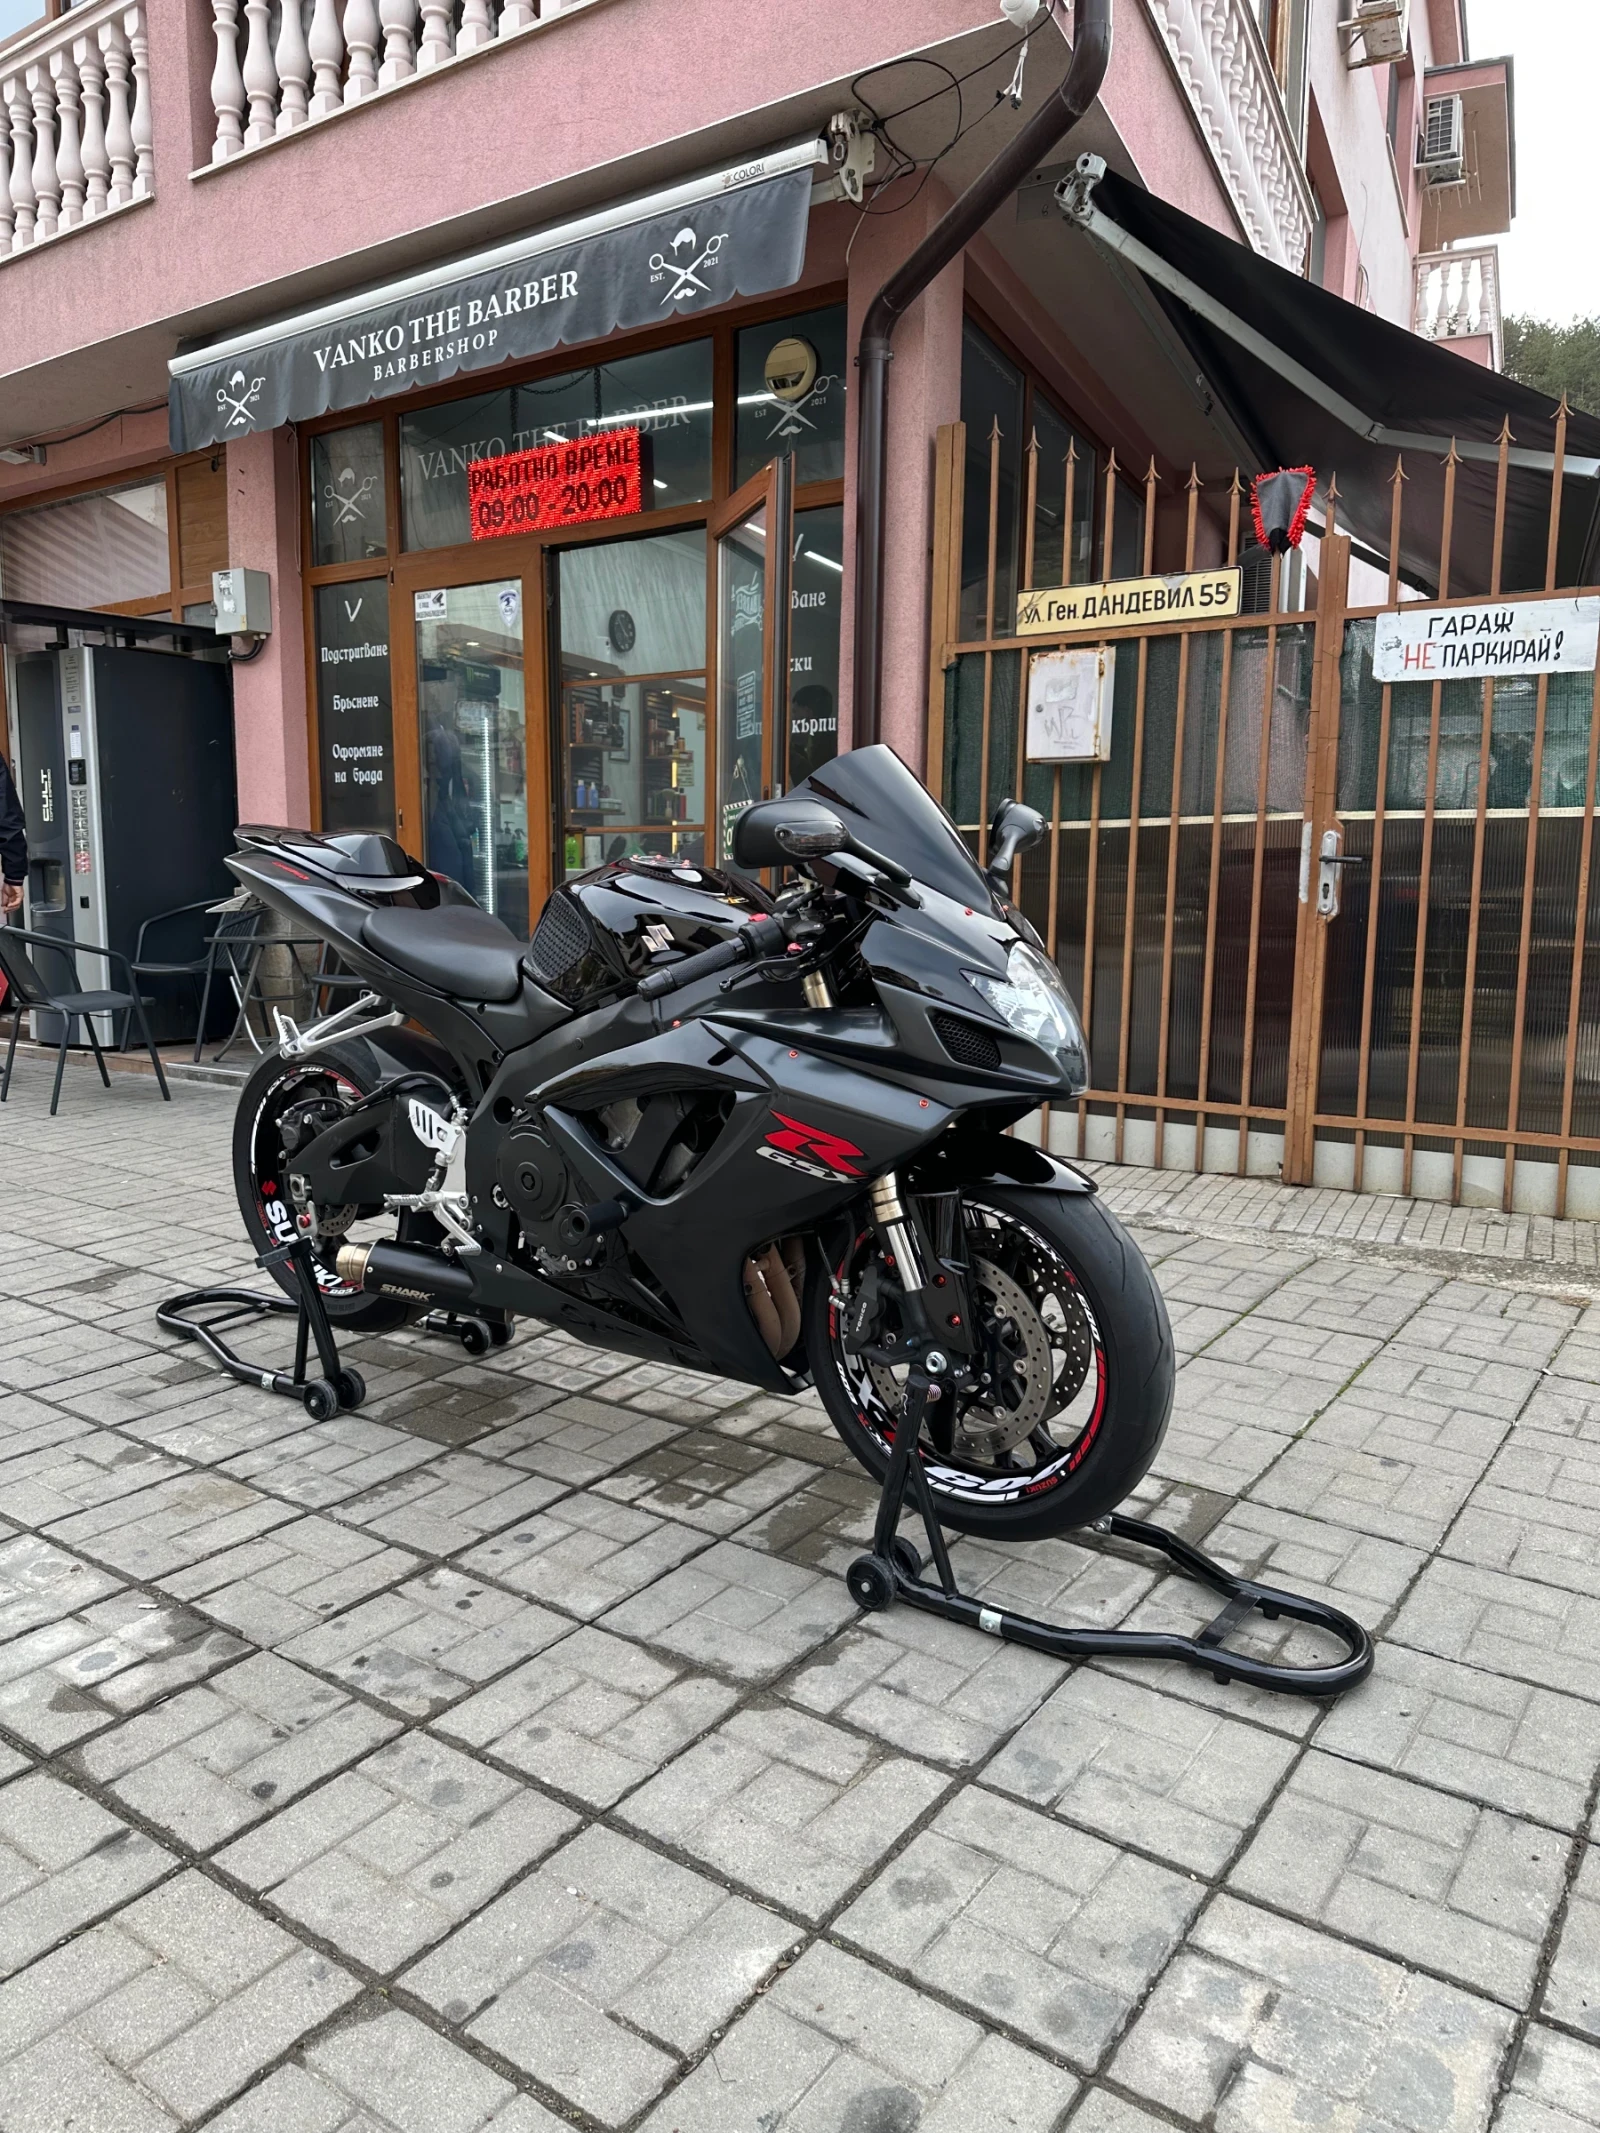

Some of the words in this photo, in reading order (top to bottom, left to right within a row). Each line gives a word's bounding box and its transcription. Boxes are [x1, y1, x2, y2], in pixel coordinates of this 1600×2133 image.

[733, 163, 765, 181] COLORI
[703, 256, 719, 269] 2021
[313, 325, 404, 372] VANKO
[408, 305, 461, 345] THE
[466, 270, 579, 327] BARBER
[373, 329, 498, 381] BARBERSHOP
[418, 437, 506, 480] VANKO
[472, 454, 559, 493] РАБОТНО
[565, 437, 635, 475] ВРЕМЕ
[479, 491, 540, 529] 09:00
[562, 474, 628, 515] 20:00
[1047, 600, 1080, 621] Ген.
[1082, 586, 1195, 619] ДАНДЕВИЛ
[1199, 581, 1231, 606] 55
[1428, 611, 1515, 638] ГАРАЖ
[321, 642, 388, 665] Подстригване
[1404, 642, 1438, 670] НЕ
[333, 695, 379, 713] Бръснене
[791, 717, 837, 736] кърпи
[332, 743, 384, 761] Оформяне
[335, 770, 347, 783] на
[353, 767, 383, 785] брада
[41, 769, 50, 821] CULT
[300, 1066, 324, 1074] 600
[764, 1108, 869, 1178] R
[755, 1146, 858, 1184] GSX
[380, 1283, 432, 1302] SHARK
[855, 1301, 868, 1333] TOKICO
[1076, 1291, 1101, 1343] 600
[836, 1360, 858, 1406] 600
[1024, 1476, 1059, 1494] SUZUKI
